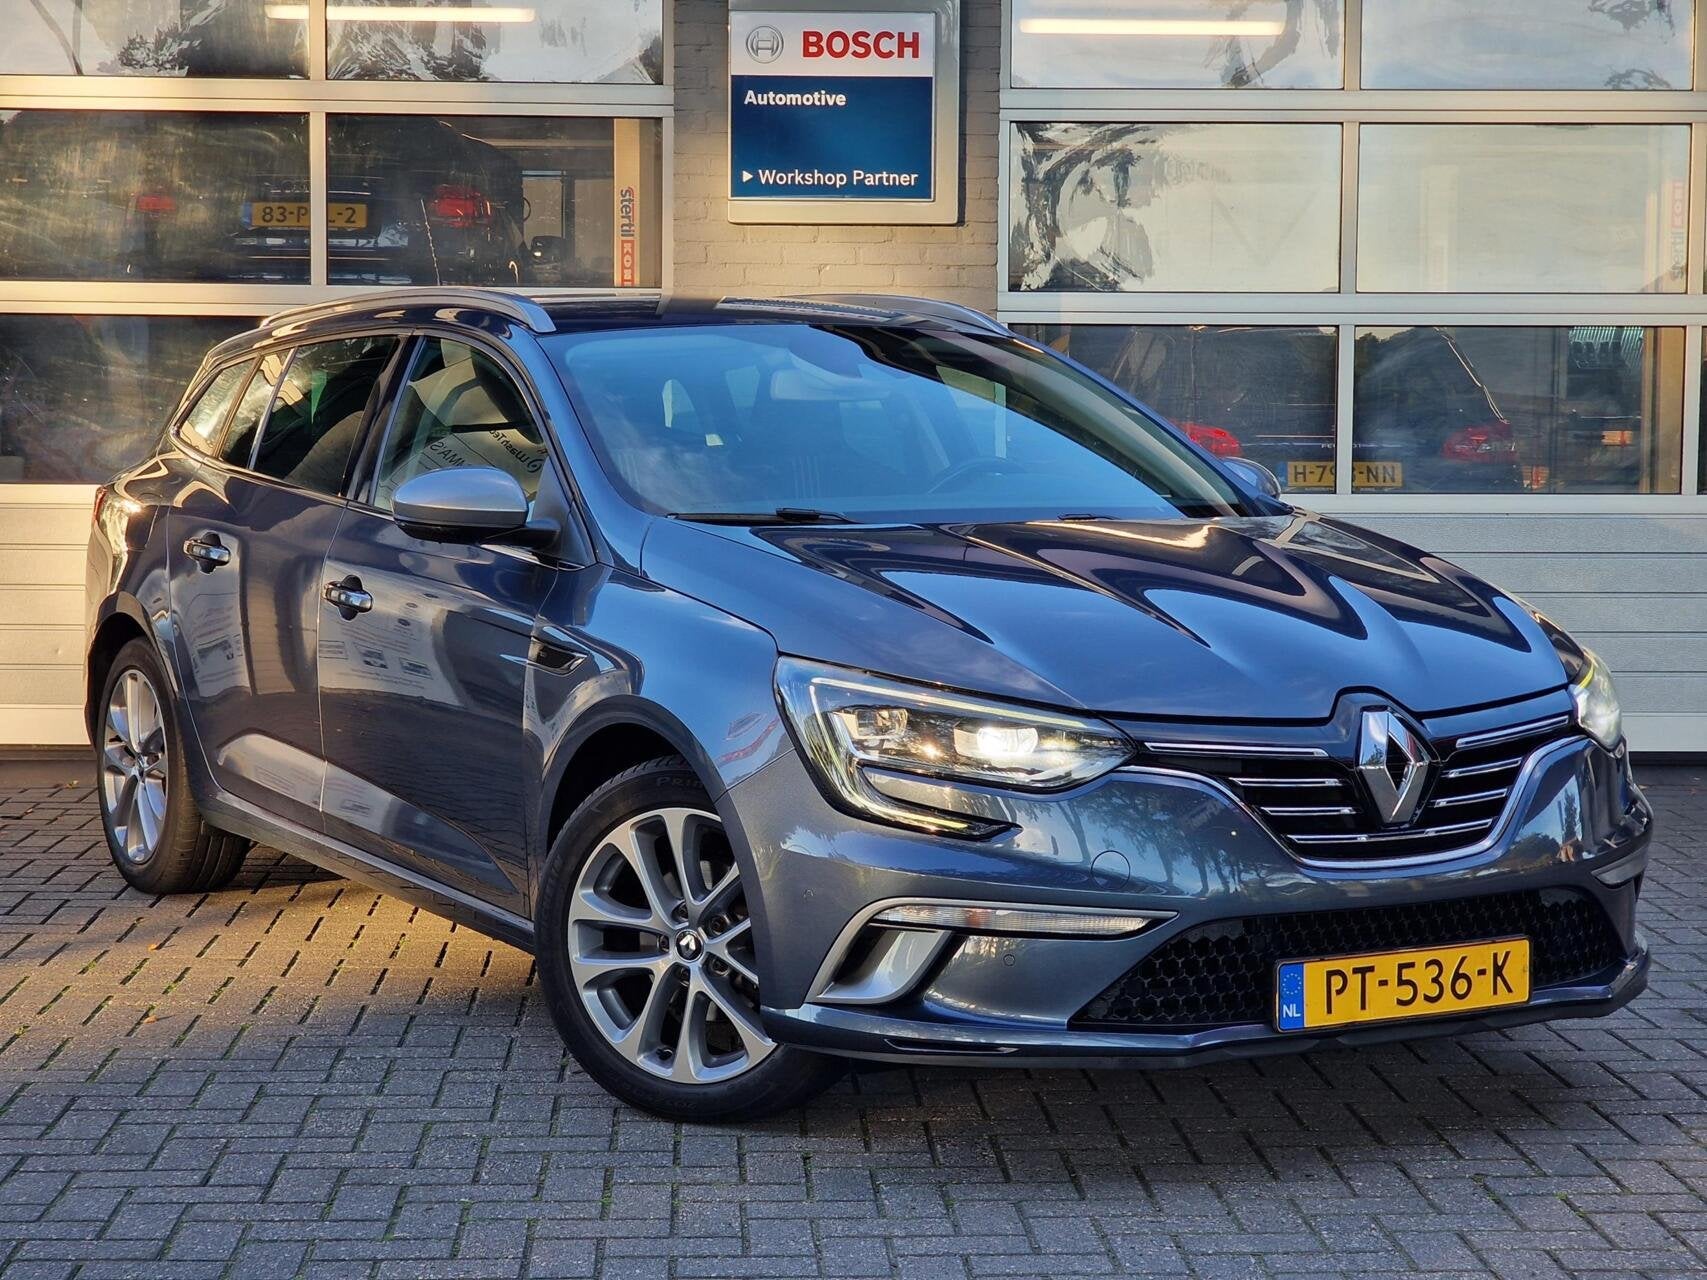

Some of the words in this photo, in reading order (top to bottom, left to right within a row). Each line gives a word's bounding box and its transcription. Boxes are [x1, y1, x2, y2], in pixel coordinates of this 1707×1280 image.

[802, 30, 920, 59] BOSCH
[743, 89, 847, 107] Automotive
[758, 169, 847, 188] Workshop
[852, 170, 919, 187] Partner
[261, 205, 357, 224] 83-P-2
[620, 188, 635, 237] stertil
[1282, 1003, 1301, 1018] NL
[1325, 950, 1514, 1015] PT-536-K
